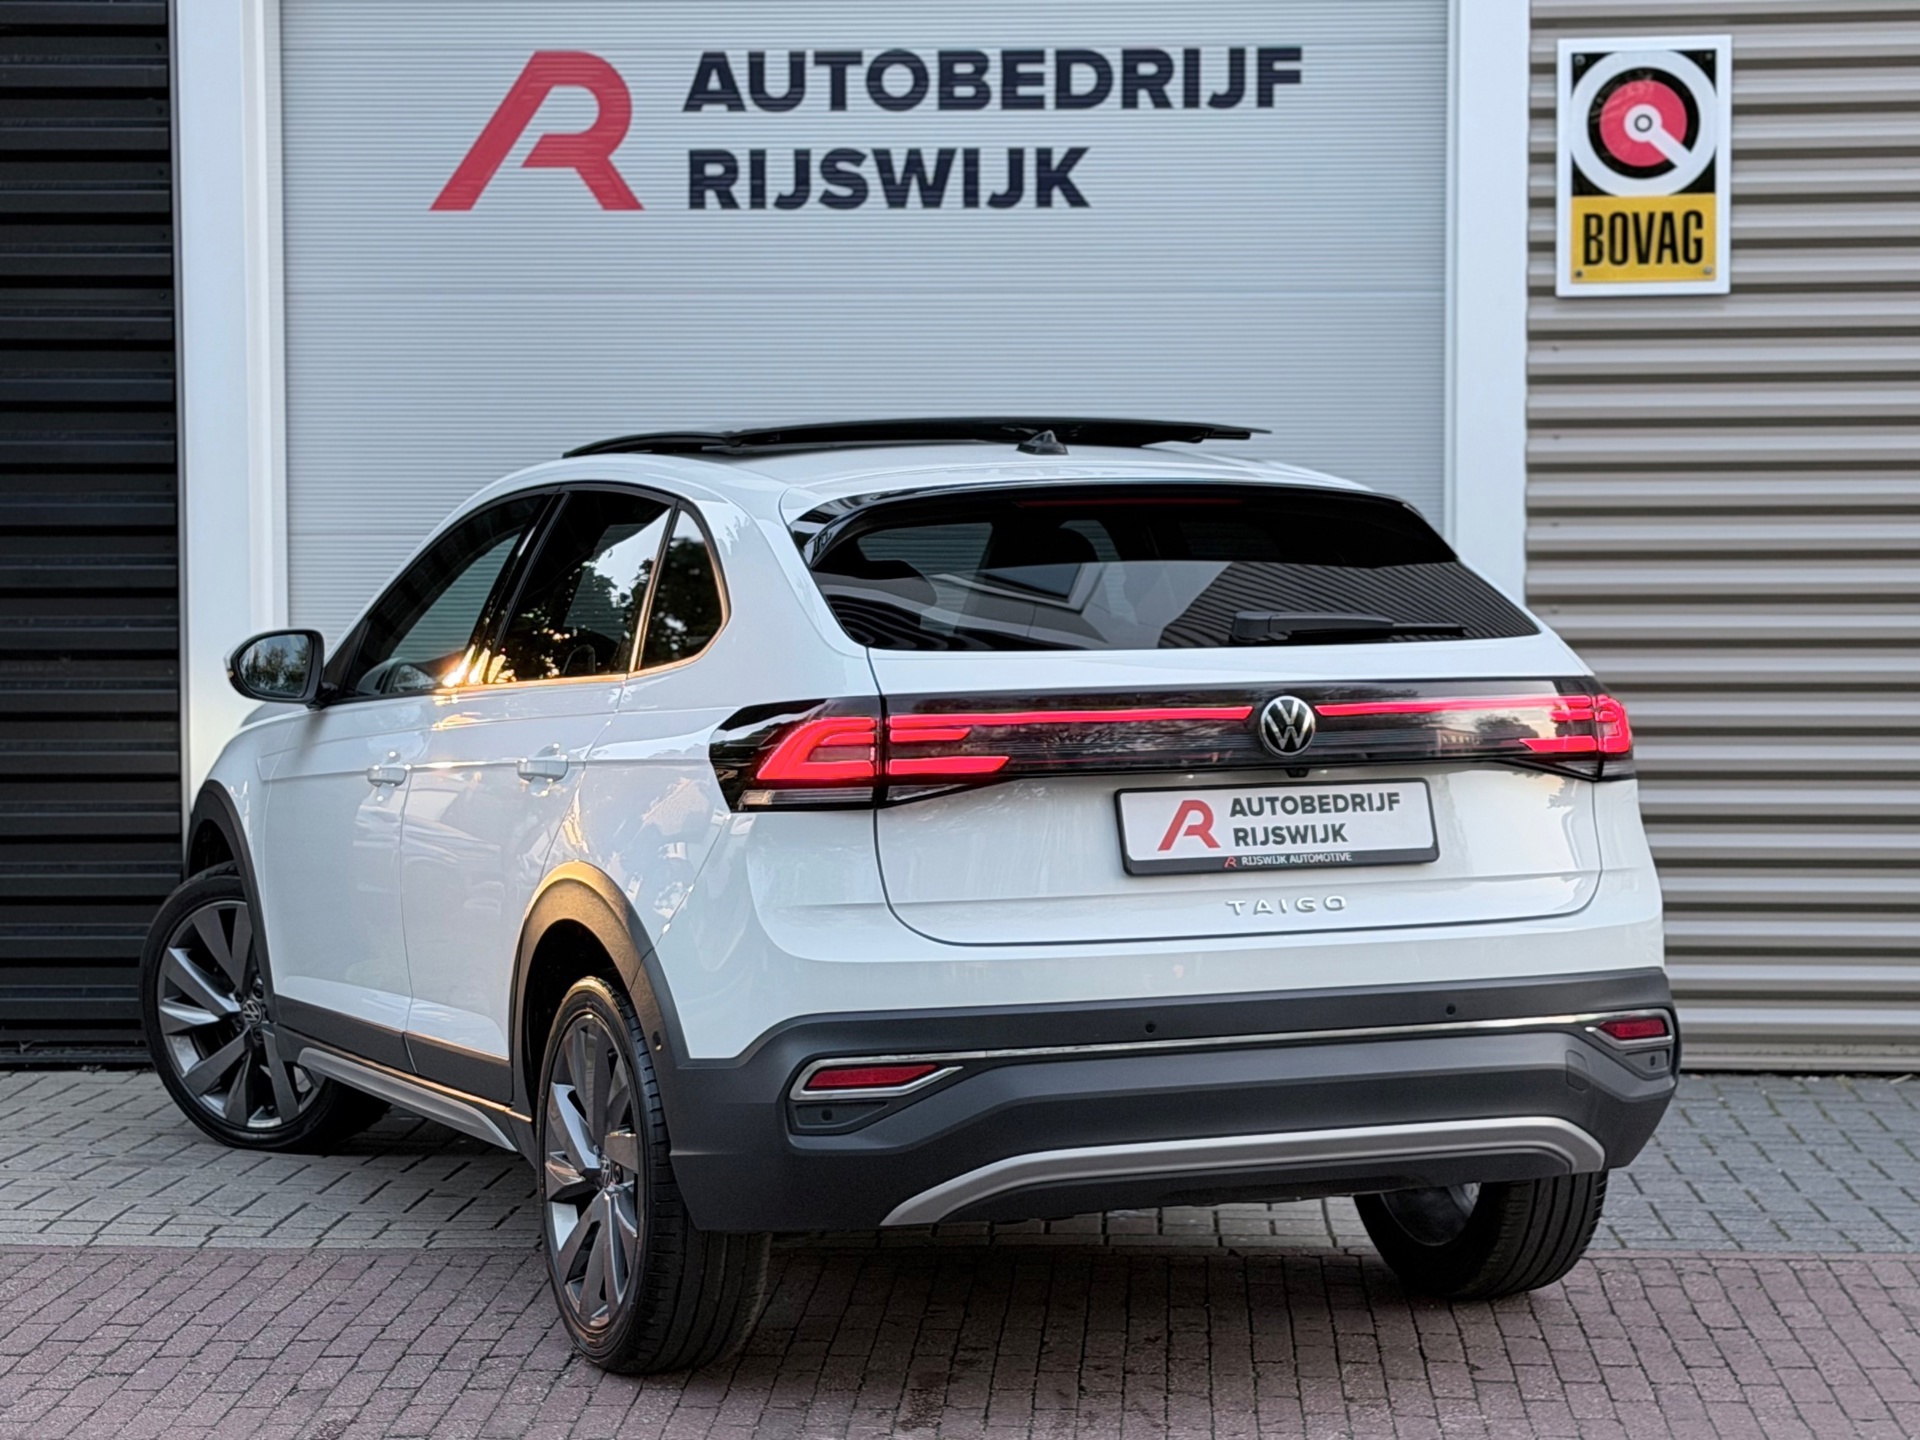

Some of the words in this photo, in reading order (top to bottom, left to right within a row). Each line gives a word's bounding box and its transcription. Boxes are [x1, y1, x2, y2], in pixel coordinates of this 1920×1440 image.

[683, 46, 1303, 113] AUTOBEDRIJF
[687, 147, 1091, 211] RIJSWIJK
[1583, 210, 1704, 266] BOVAG
[1229, 792, 1401, 818] AUTOBEDRIJF
[1233, 823, 1348, 847] RIJSWIJK
[1241, 855, 1287, 866] RIJSWIJK
[1289, 852, 1353, 863] AUTOMOTIVE
[1226, 895, 1348, 916] TAIGO
